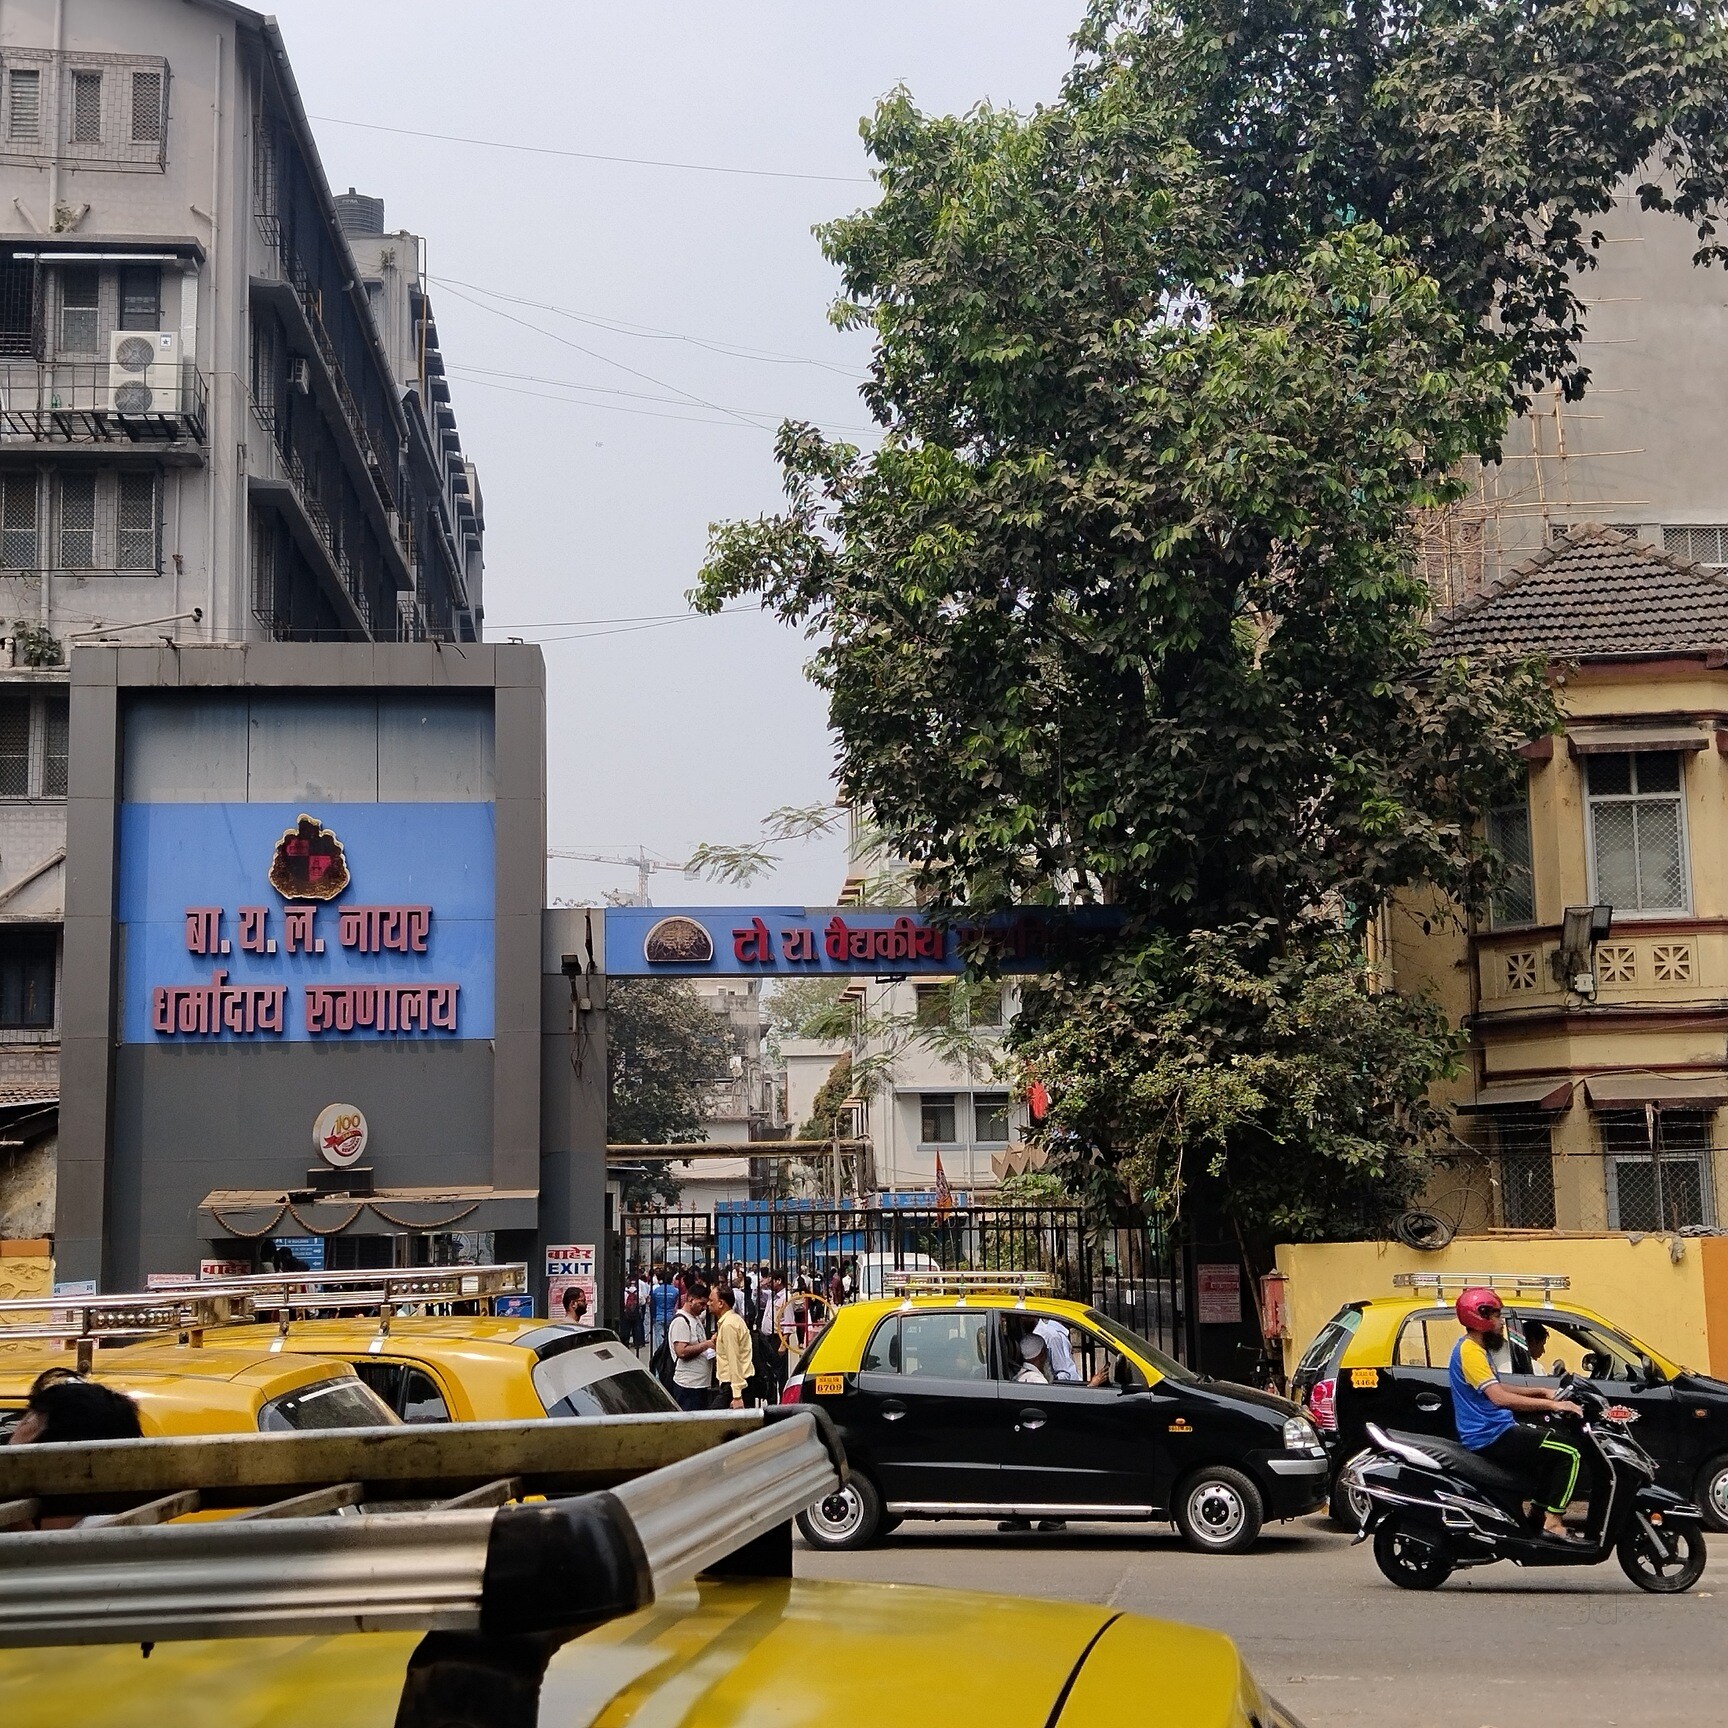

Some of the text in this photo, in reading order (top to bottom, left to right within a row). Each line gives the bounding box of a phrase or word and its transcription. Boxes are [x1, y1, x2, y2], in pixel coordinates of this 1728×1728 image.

[185, 905, 433, 954] बा. य. ल. नायर
[732, 916, 775, 962] टो.
[781, 929, 819, 961] रा.
[824, 916, 943, 961] वैद्यकीय
[153, 968, 460, 1034] धर्मादाय रुग्णालय
[335, 1113, 361, 1135] 100
[547, 1246, 594, 1260] बाहेर
[548, 1262, 593, 1275] EXIT
